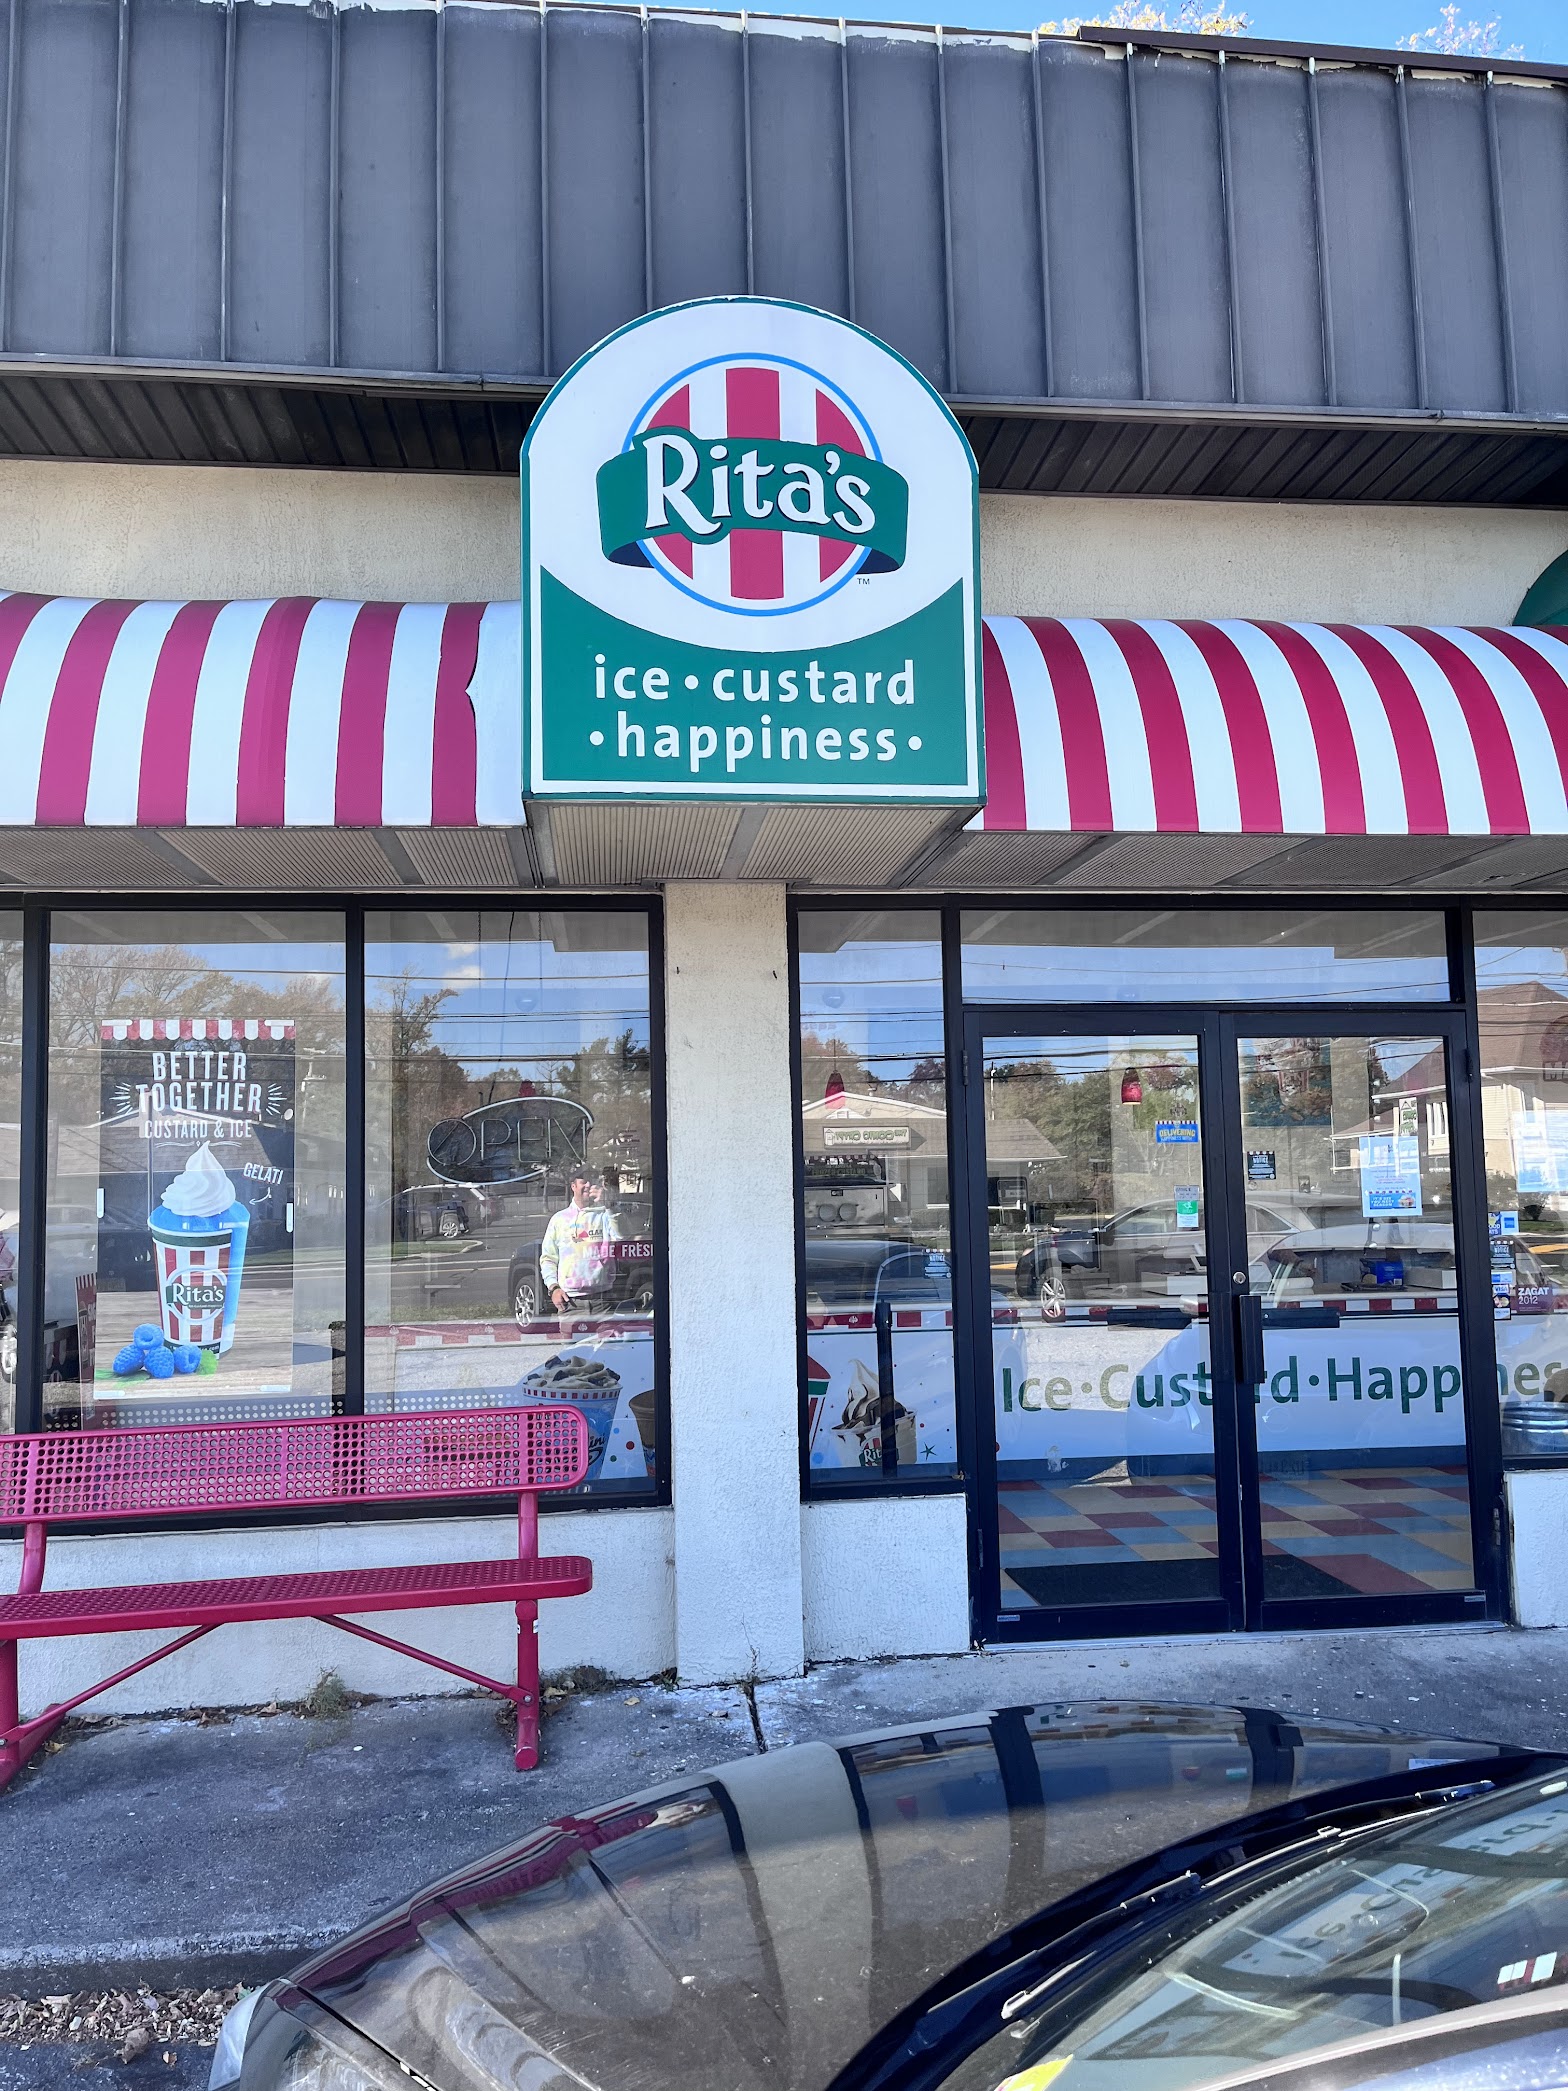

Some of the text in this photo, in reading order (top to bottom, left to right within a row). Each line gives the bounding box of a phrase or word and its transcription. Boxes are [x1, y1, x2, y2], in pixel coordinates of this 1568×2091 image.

[642, 433, 877, 537] Rita's
[857, 577, 870, 585] TM
[594, 653, 915, 705] ice custard
[617, 710, 898, 773] happiness
[152, 1051, 247, 1081] BETTER
[135, 1081, 262, 1113] TOGETHER
[144, 1119, 252, 1139] CUSTARD & ICE
[1160, 1129, 1195, 1137] DELIVERING
[428, 1117, 587, 1166] OPEN
[243, 1162, 284, 1185] GELATI
[622, 1244, 653, 1258] FRES
[172, 1283, 224, 1305] Rita's
[1518, 1287, 1550, 1296] ZAGAT
[1518, 1296, 1539, 1305] 2012
[1002, 1368, 1072, 1413] Ice
[1100, 1356, 1299, 1408] Custd
